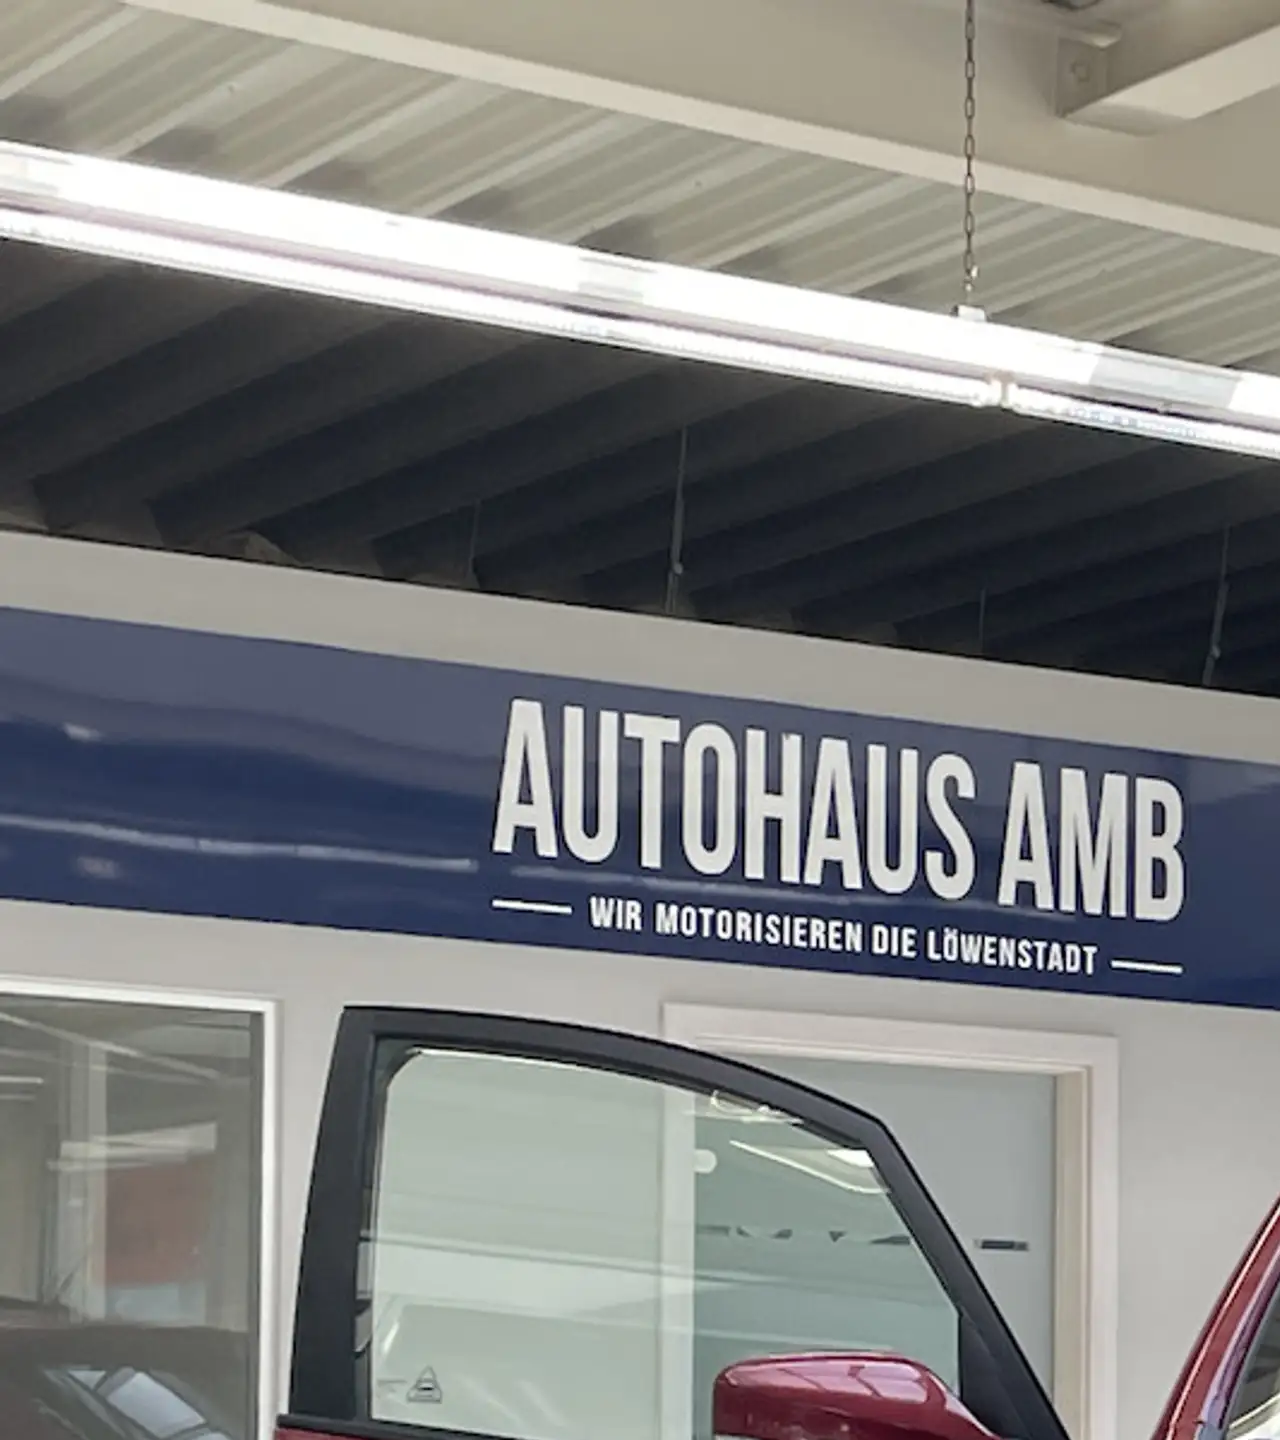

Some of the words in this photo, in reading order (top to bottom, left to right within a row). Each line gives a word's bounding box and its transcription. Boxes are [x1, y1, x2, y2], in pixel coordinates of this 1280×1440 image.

[491, 698, 976, 901] AUTOHAUS
[997, 761, 1186, 922] AMB
[590, 896, 642, 932] WIR
[655, 903, 862, 953] MOTORISIEREN
[872, 924, 917, 959] DIE
[926, 928, 1098, 975] LÖWENSTADT
